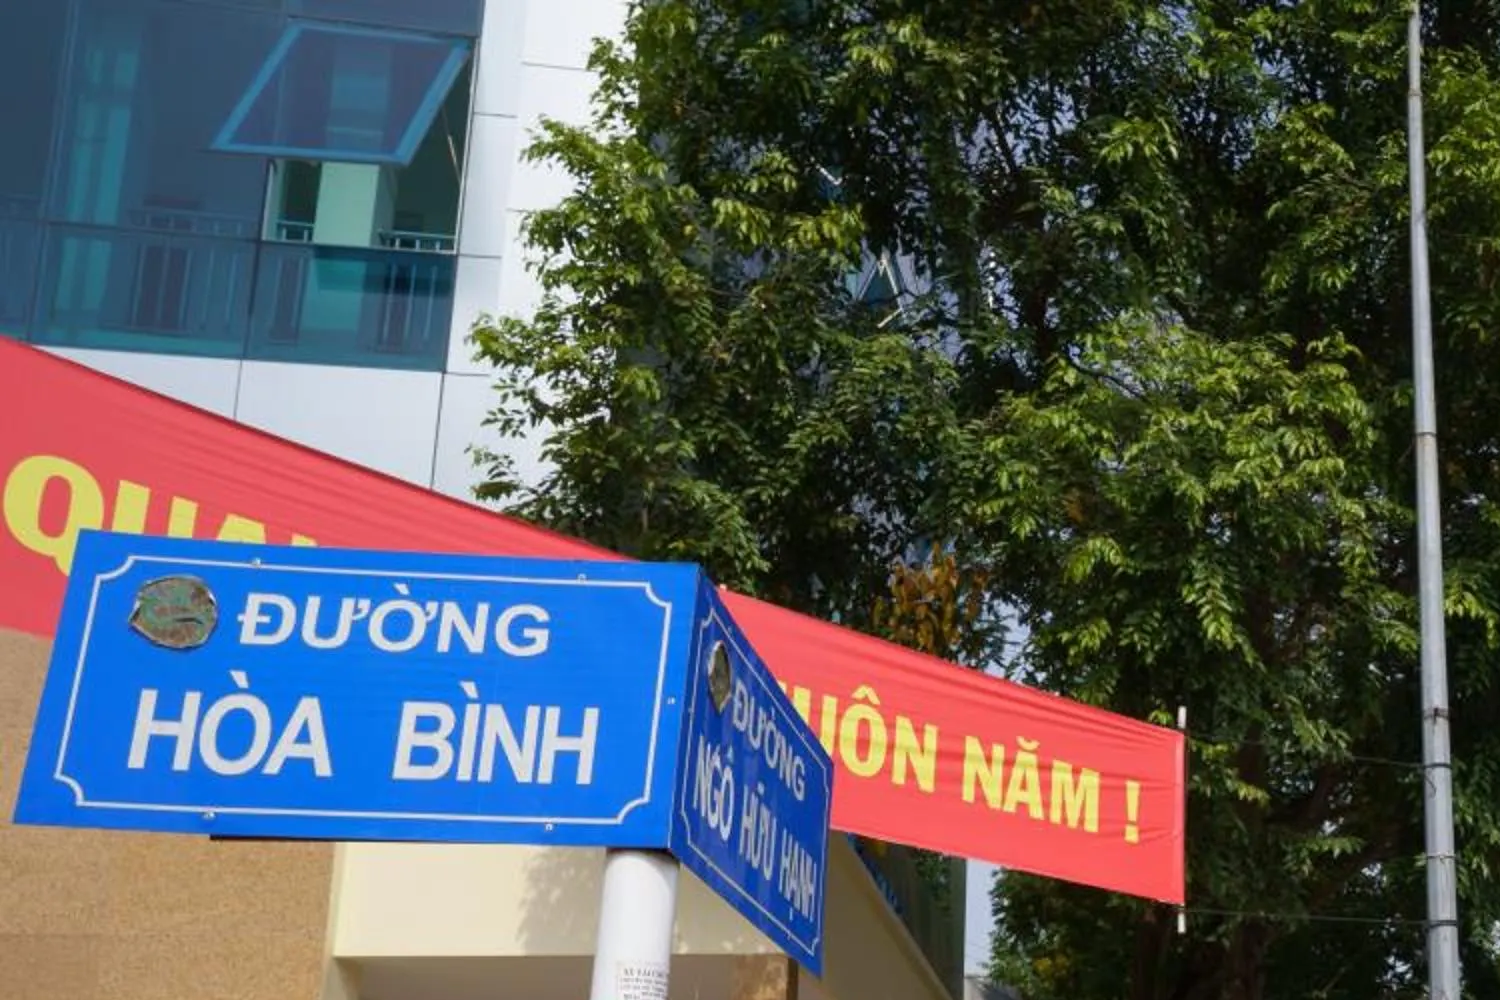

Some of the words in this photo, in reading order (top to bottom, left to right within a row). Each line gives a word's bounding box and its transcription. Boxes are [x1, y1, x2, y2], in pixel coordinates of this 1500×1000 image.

[238, 584, 551, 658] ĐƯỜNG
[127, 670, 333, 778] HÒA
[392, 681, 599, 785] BÌNH
[732, 679, 806, 801] ĐƯỜNG
[962, 736, 1099, 833] NĂM
[739, 782, 777, 880] HỮU
[778, 828, 818, 922] HẠNH
